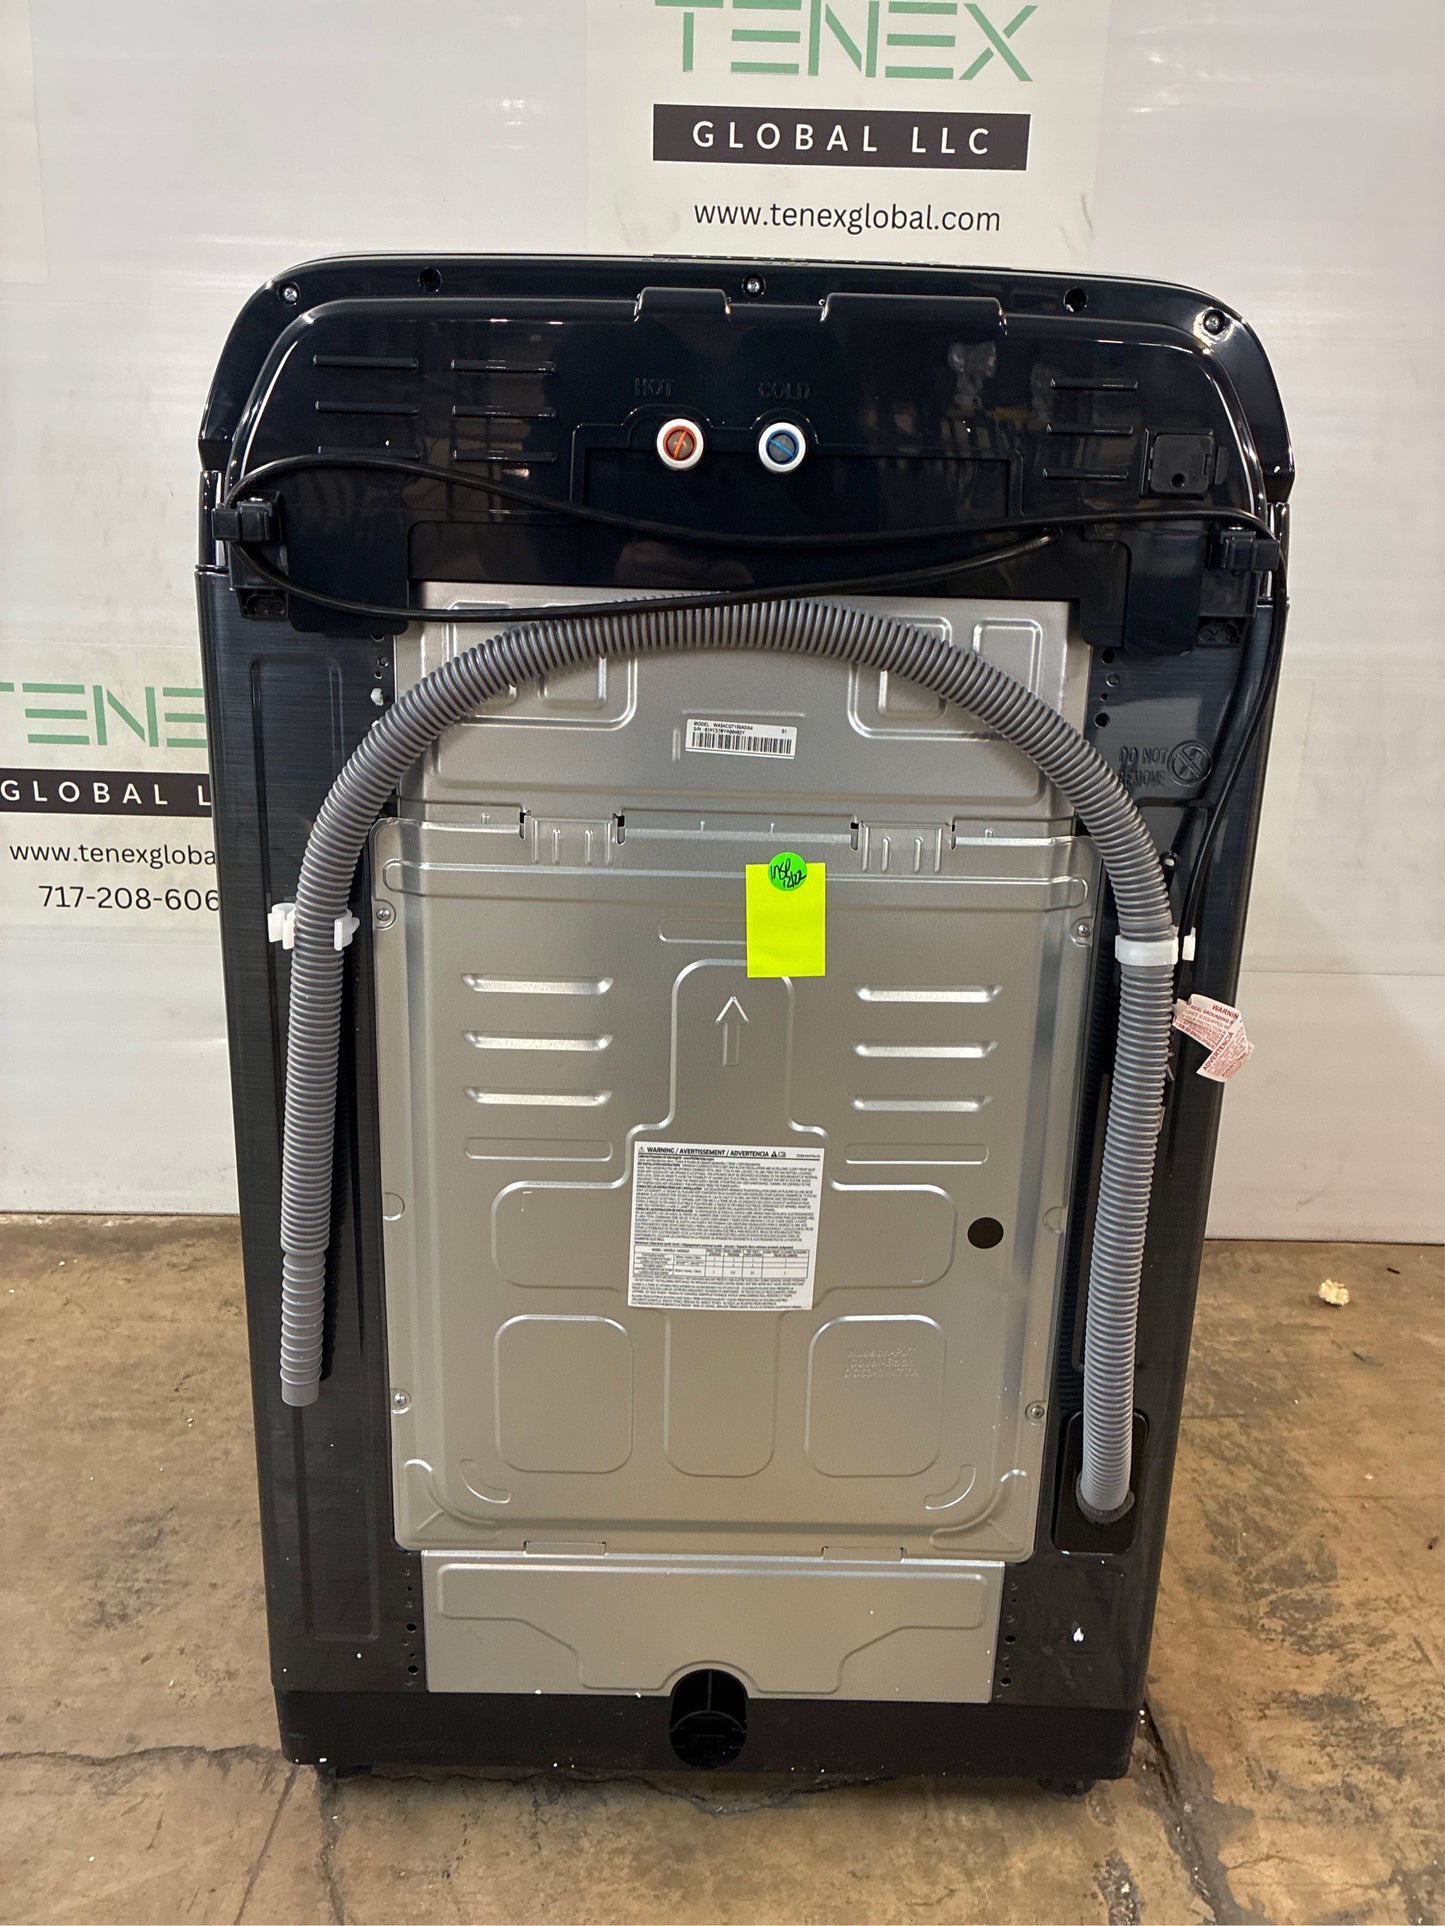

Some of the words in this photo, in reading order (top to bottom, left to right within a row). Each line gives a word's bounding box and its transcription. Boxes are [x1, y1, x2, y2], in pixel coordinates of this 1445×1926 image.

[655, 0, 1038, 82] TENEX
[692, 120, 878, 153] GLOBAL
[910, 126, 990, 155] LLC
[693, 202, 1001, 234] www.tenexglobal.com
[634, 377, 675, 397] HOT
[758, 382, 810, 400] COLD
[0, 682, 208, 748] ENE
[1119, 745, 1139, 764] DO
[1142, 747, 1169, 764] NOT
[0, 779, 168, 805] GLOBAL
[647, 1146, 675, 1154] WARNING
[679, 1148, 725, 1156] AVERTISSEMENT
[730, 1150, 769, 1158] ADVERTENCIA
